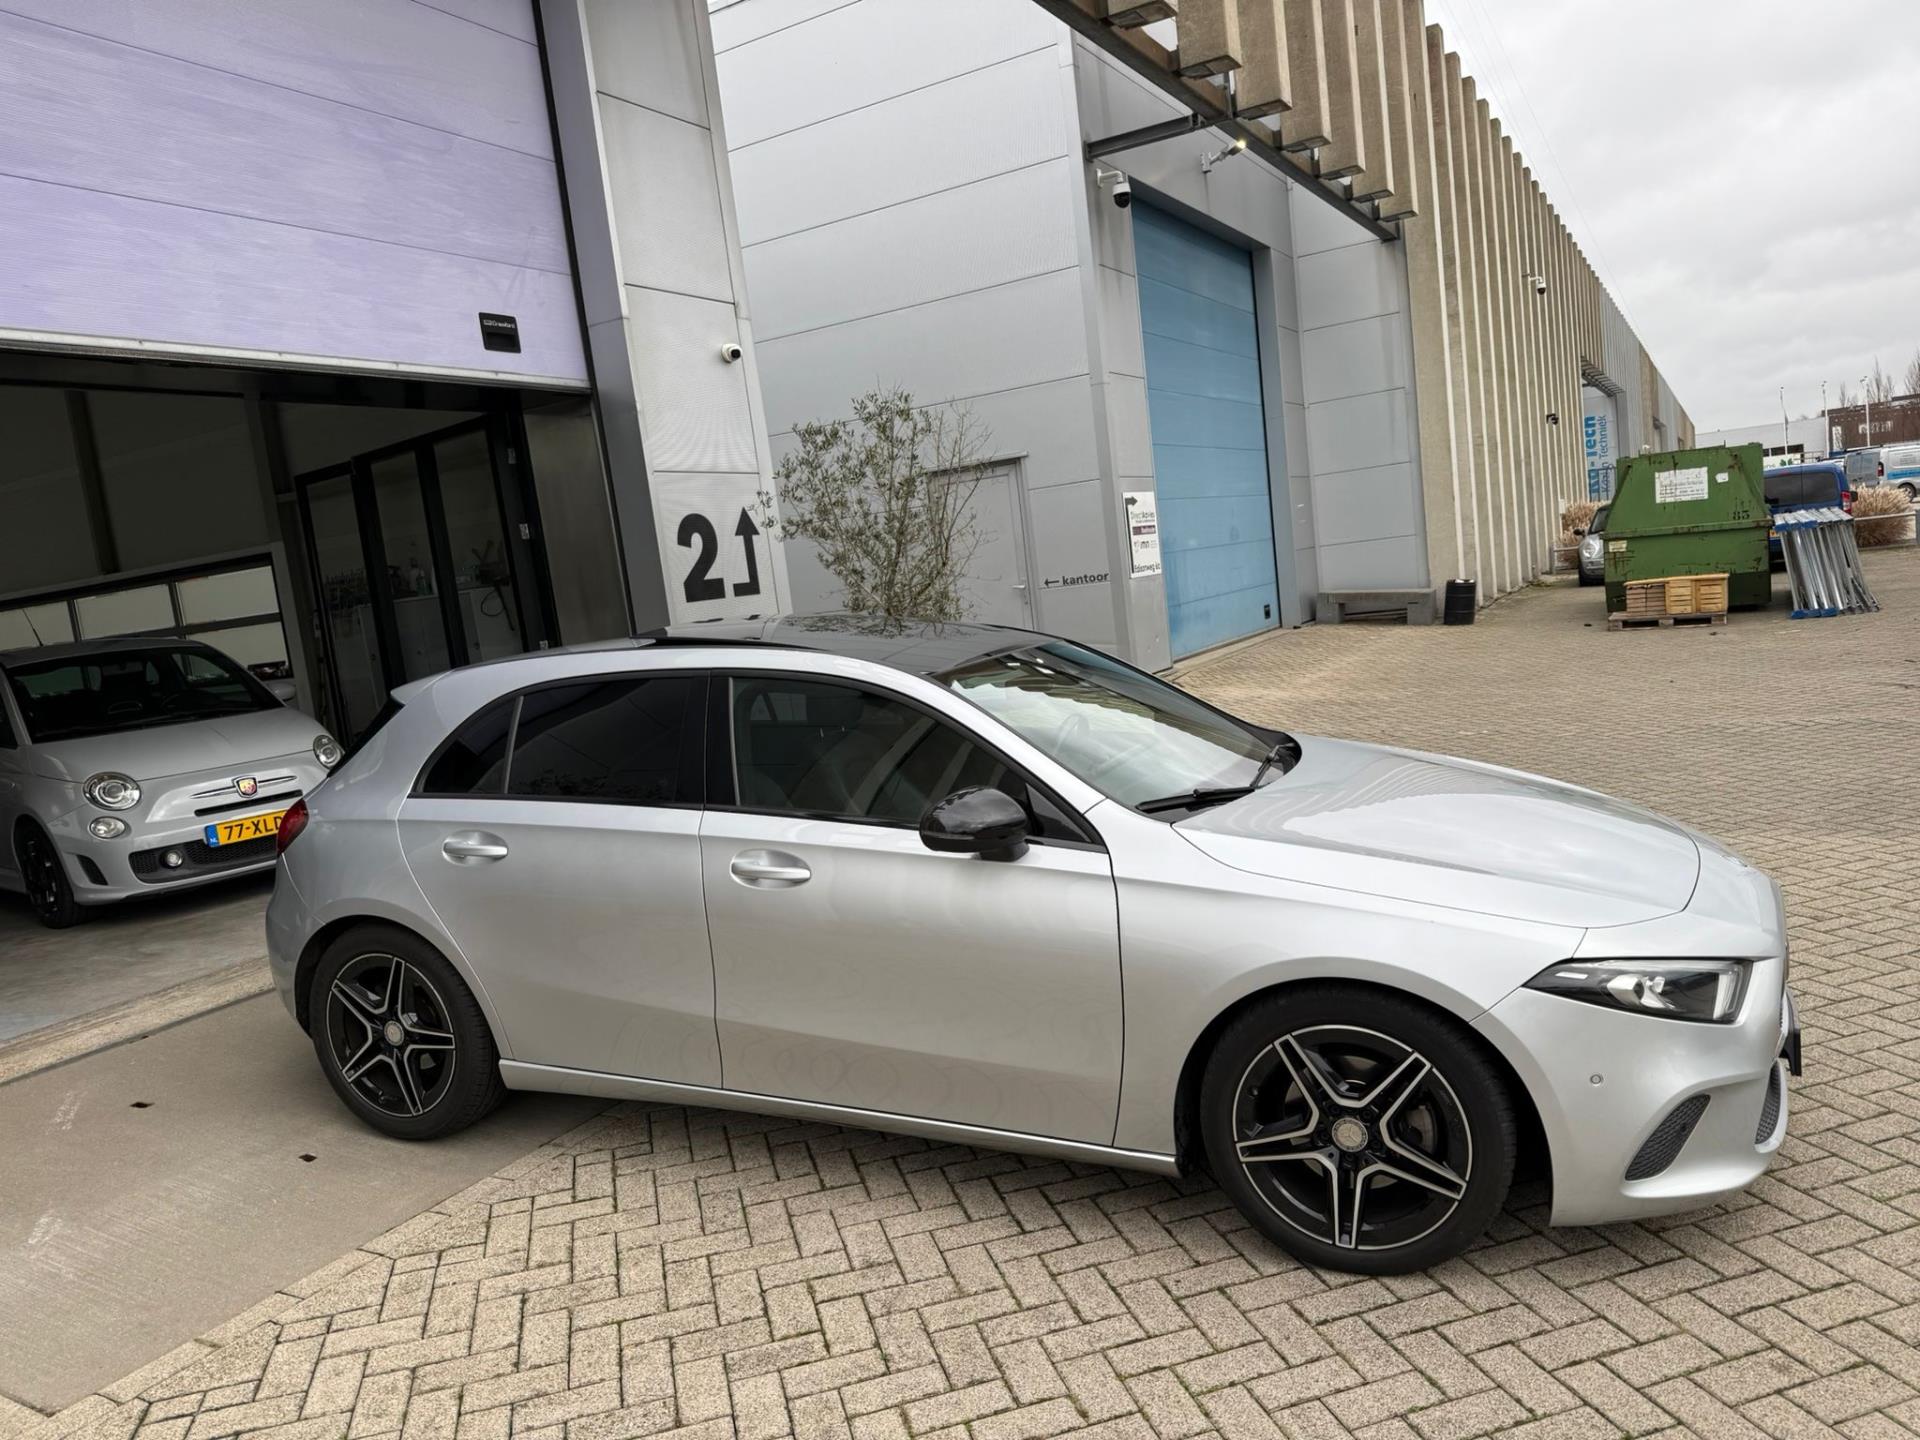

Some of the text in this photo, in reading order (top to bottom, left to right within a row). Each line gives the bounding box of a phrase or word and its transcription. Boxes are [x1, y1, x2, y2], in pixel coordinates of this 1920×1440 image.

[1597, 414, 1609, 460] Techniek
[677, 513, 726, 603] 2
[1062, 573, 1109, 585] kantoor
